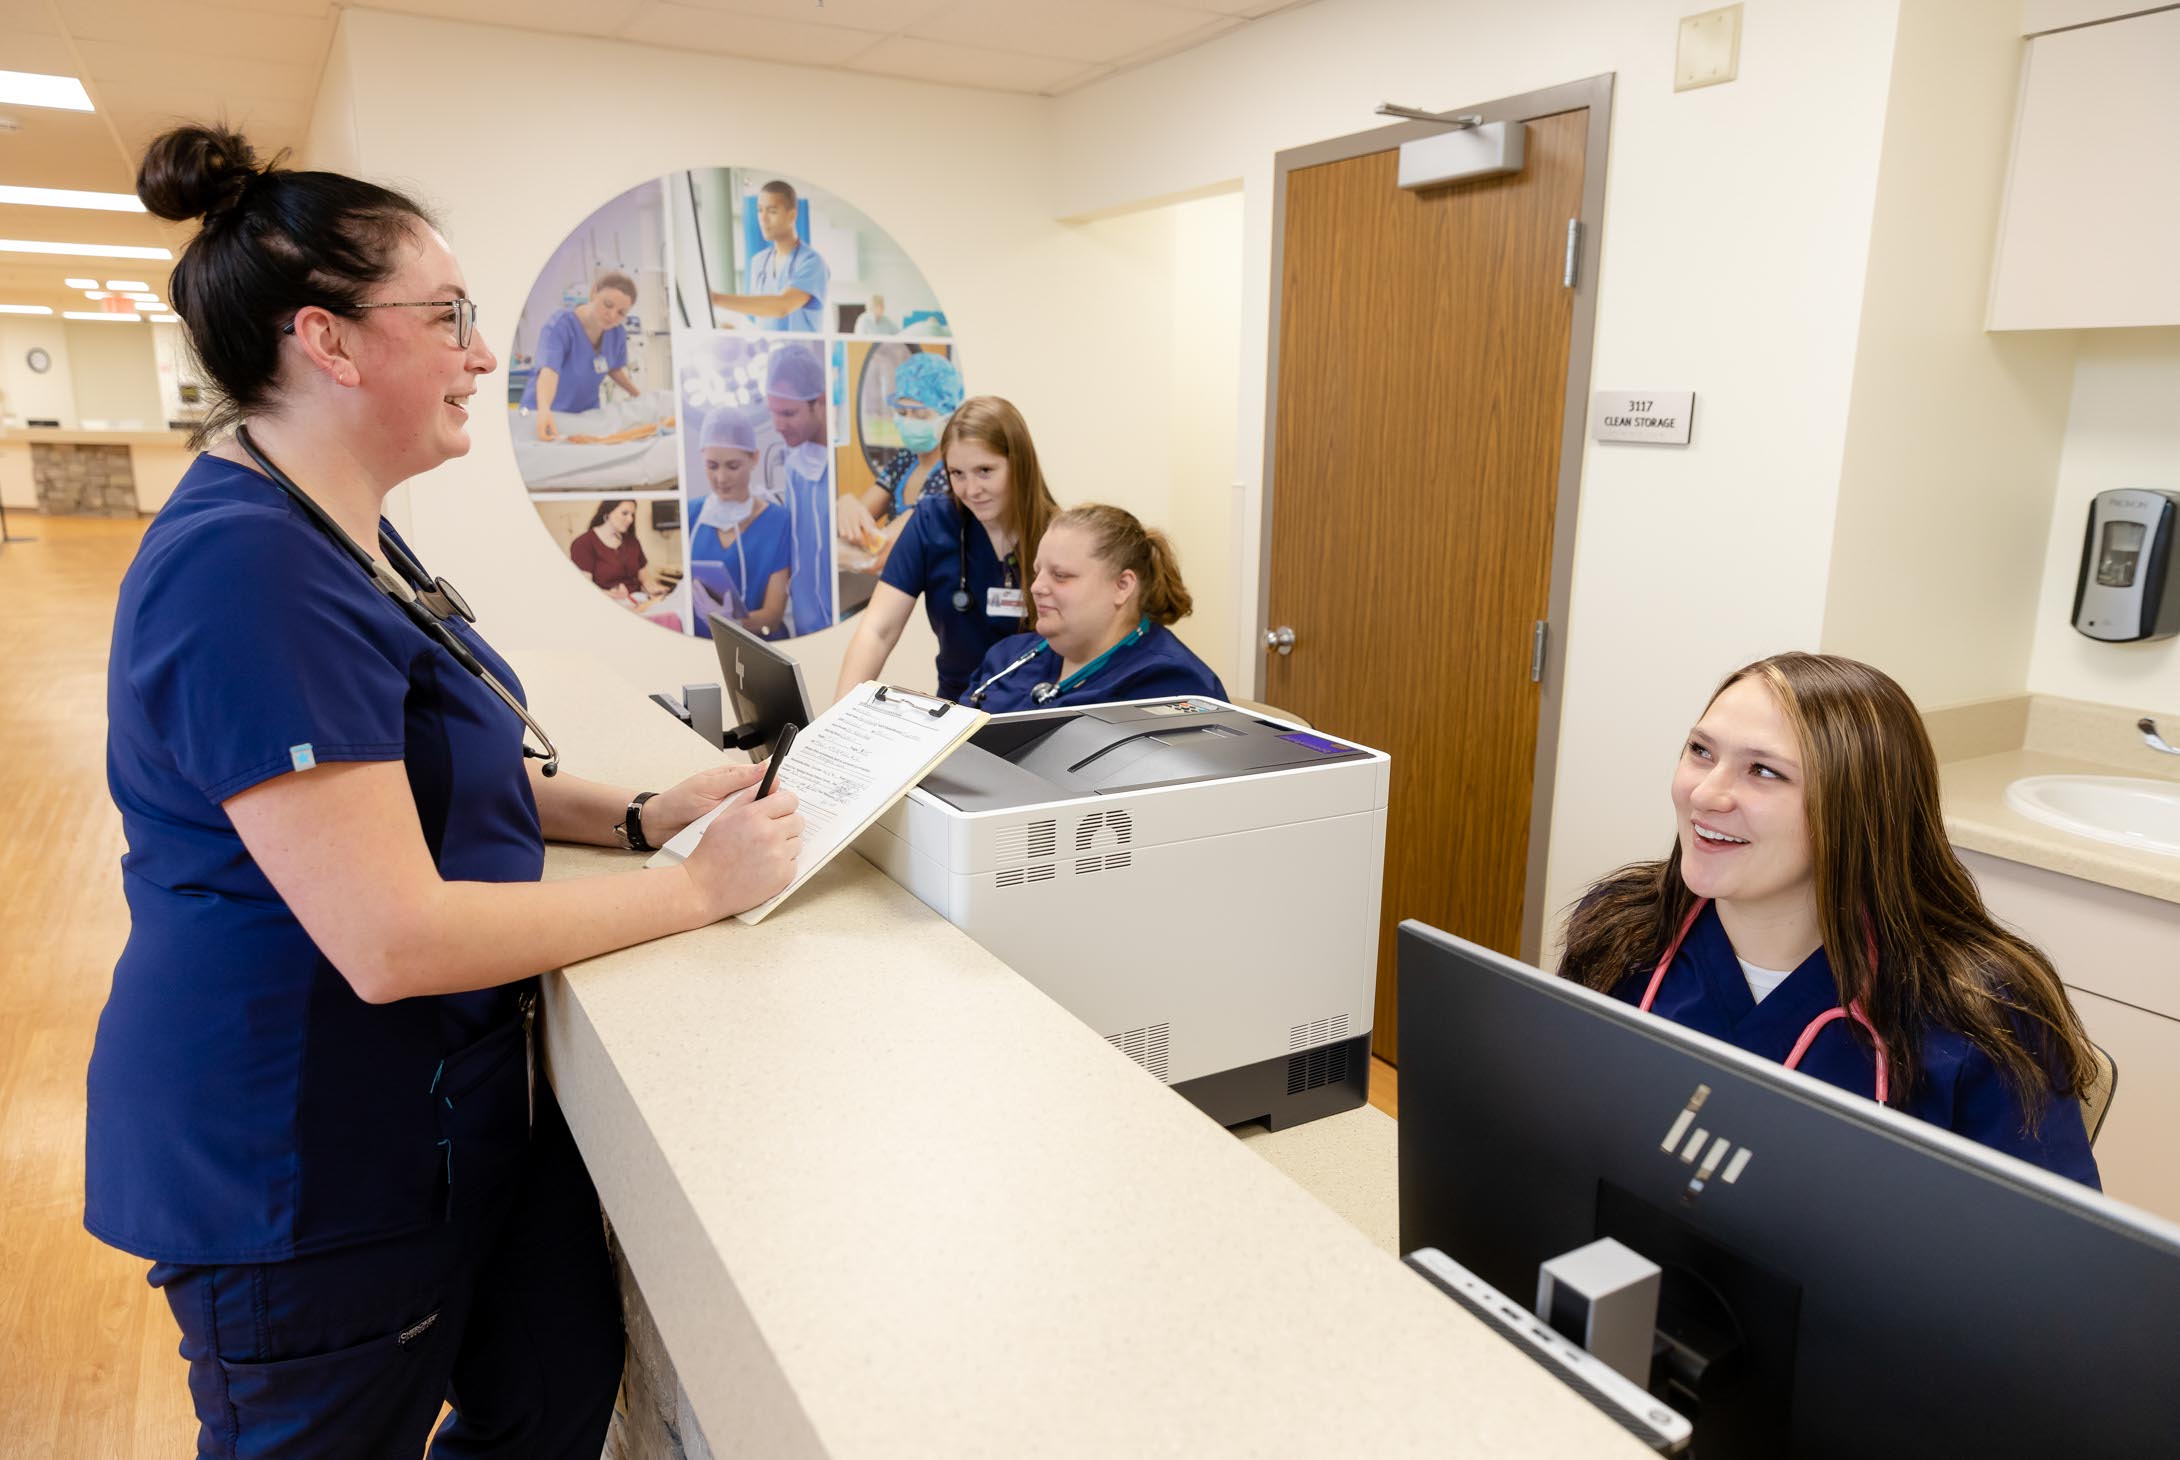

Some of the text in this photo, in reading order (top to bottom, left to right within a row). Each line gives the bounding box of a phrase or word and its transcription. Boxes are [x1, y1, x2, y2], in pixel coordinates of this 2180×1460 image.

[1628, 400, 1654, 412] 3117
[1604, 416, 1676, 429] CLEAN STORAGE
[1660, 1083, 1753, 1201] hp
